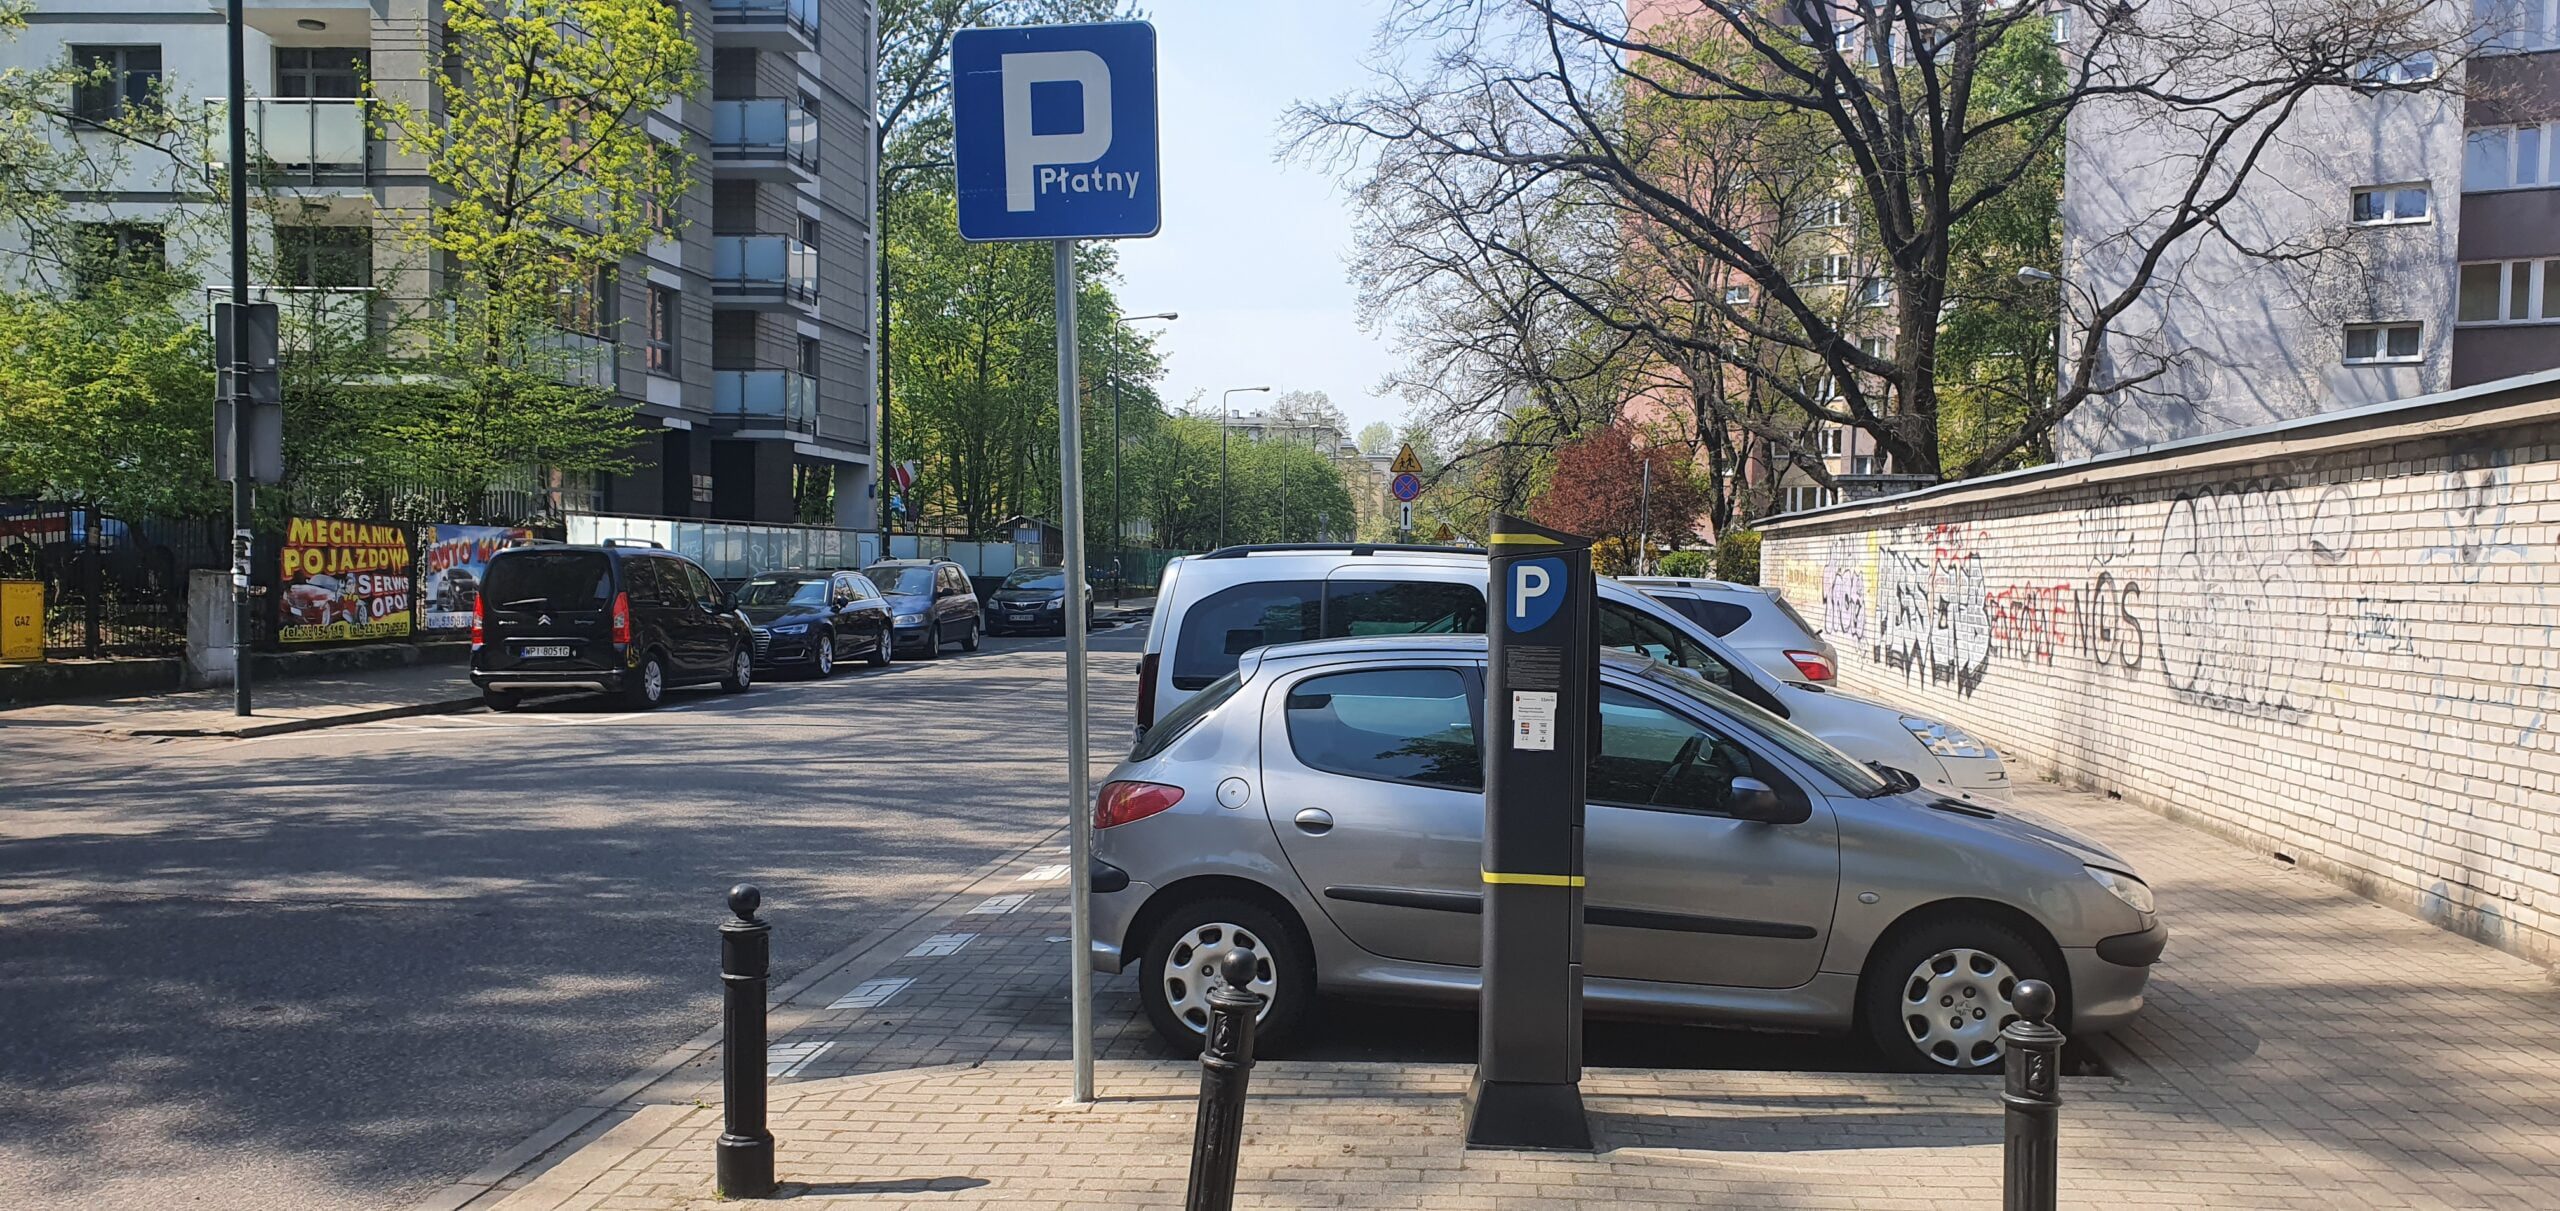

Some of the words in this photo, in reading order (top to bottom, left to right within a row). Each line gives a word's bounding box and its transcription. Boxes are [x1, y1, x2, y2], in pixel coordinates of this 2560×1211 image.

[1002, 50, 1112, 212] P
[1040, 165, 1140, 199] Płatny
[288, 517, 406, 546] MECHANIKA
[282, 547, 410, 578] POJAZDOWA
[428, 538, 472, 575] AUTO
[1516, 565, 1551, 618] P
[14, 615, 31, 627] GAZ
